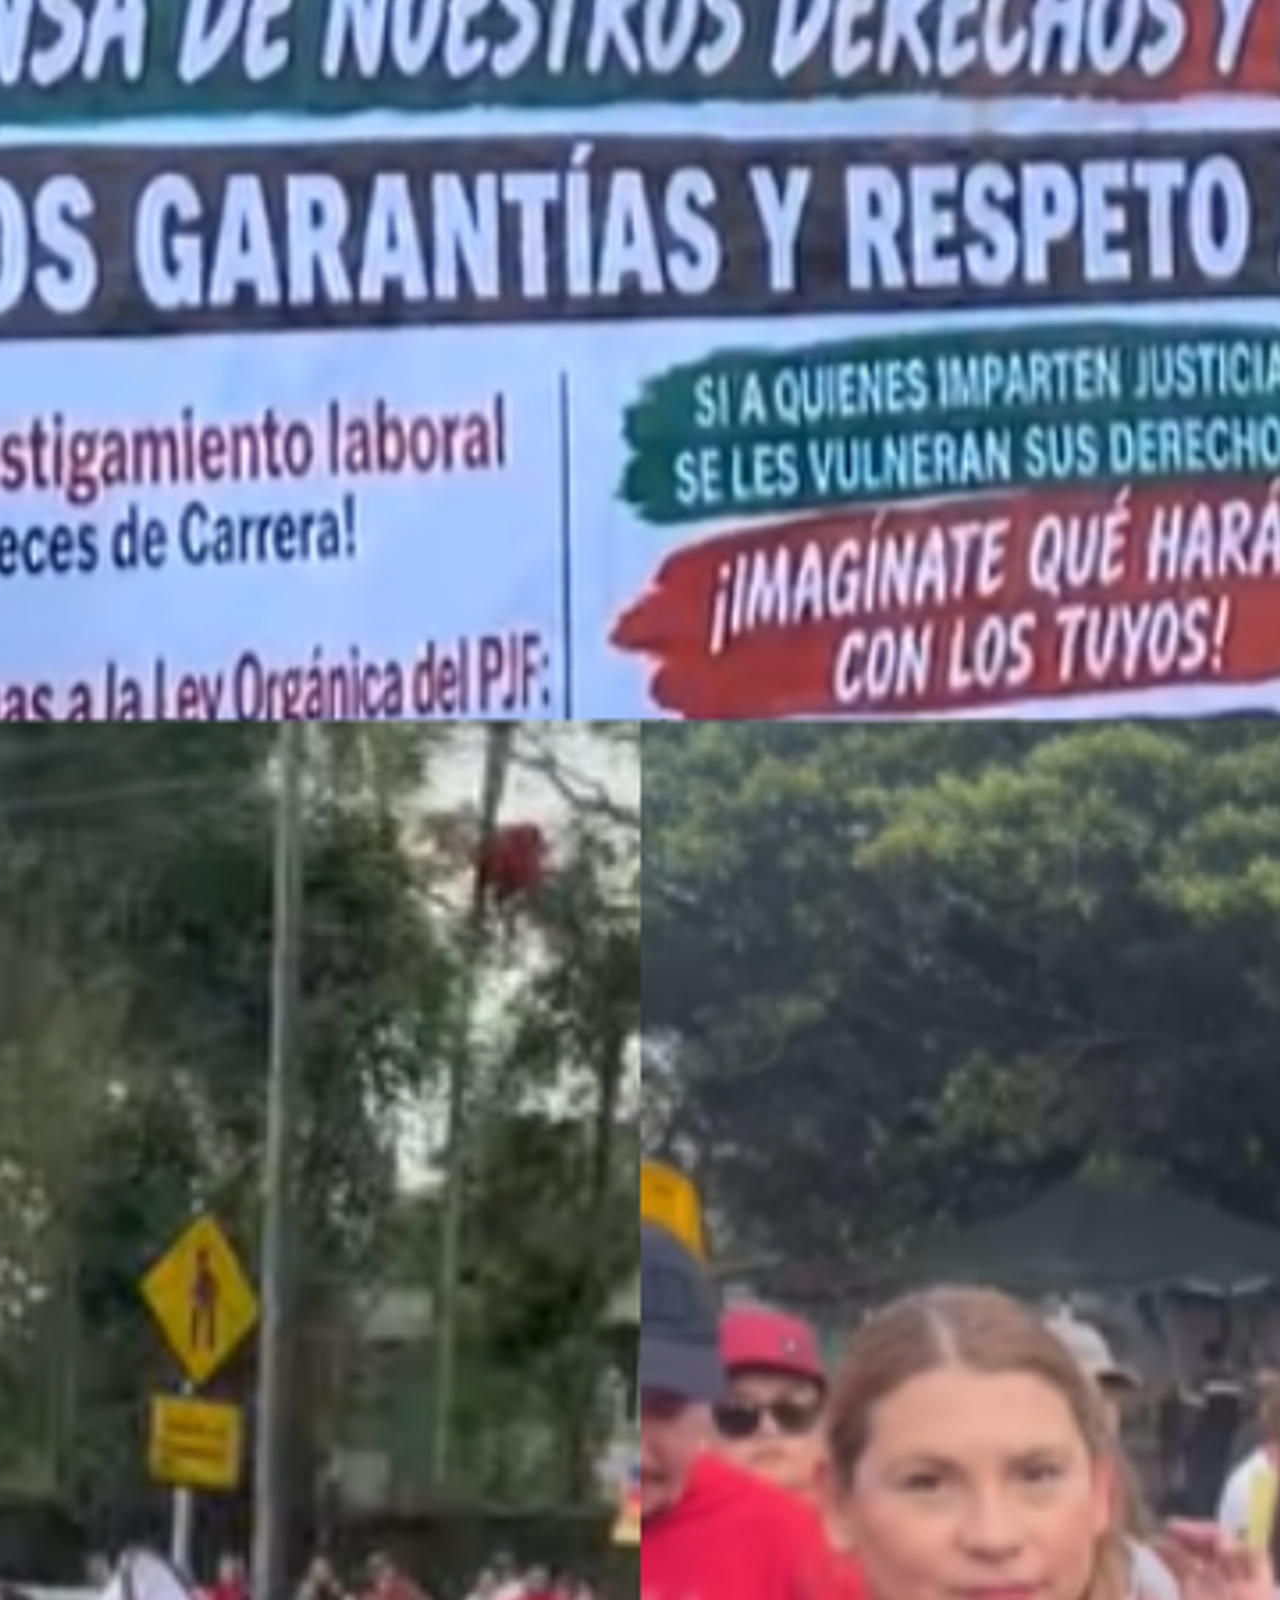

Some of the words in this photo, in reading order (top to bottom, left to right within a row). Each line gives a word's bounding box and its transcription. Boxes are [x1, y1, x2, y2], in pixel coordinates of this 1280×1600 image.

[135, 142, 720, 311] GARANTÍAS
[749, 166, 812, 291] Y
[844, 160, 1250, 290] RESPETO
[693, 374, 729, 428] SI
[741, 374, 767, 424] A
[773, 365, 926, 424] QUIENES
[938, 349, 1122, 412] IMPARTEN
[328, 392, 507, 474] laboral
[673, 449, 721, 505] SE
[731, 442, 800, 501] LES
[808, 428, 1012, 494] VULNERAN
[1024, 425, 1100, 479] SUS
[112, 504, 168, 571] de
[178, 493, 358, 565] Carrera!
[709, 511, 1011, 654] ¡IMAGÍNATE
[1028, 487, 1131, 589] QUÉ
[70, 684, 99, 721] a
[107, 662, 142, 721] la
[234, 646, 405, 721] Orgánica
[412, 636, 468, 716] del
[481, 632, 551, 712] PJF:
[834, 625, 935, 705] CON
[947, 613, 1037, 690] LOS
[1055, 596, 1232, 681] TUYOS!
